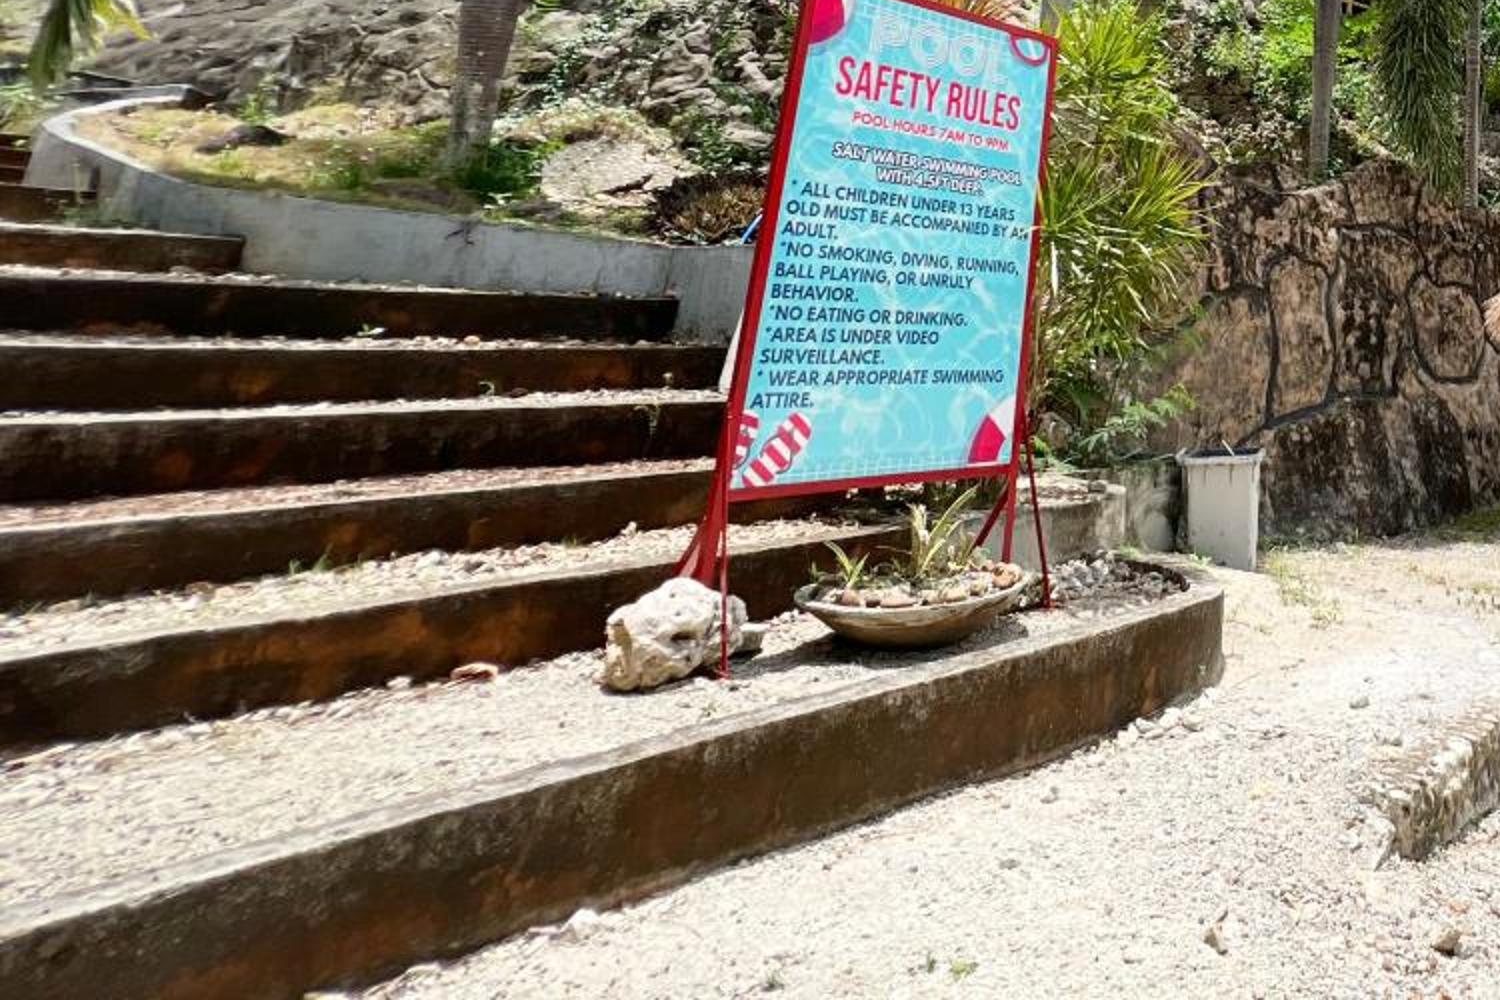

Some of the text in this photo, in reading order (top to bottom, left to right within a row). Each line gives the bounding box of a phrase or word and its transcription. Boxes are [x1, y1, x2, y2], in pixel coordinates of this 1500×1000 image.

[869, 12, 1008, 85] POOL
[835, 55, 1022, 131] SAFETY RULES
[851, 111, 891, 130] POOL
[893, 120, 936, 137] HOURS
[938, 127, 966, 143] 7AM
[968, 133, 983, 147] TO
[832, 141, 1022, 186] SALT WATER SWIMMING POOL
[876, 166, 914, 185] WITH
[801, 181, 1016, 221] ALL CHILDREN UNDER 13 YEARS
[781, 219, 839, 240] ADULT.
[786, 199, 821, 217] OLD
[823, 204, 869, 222] MUST
[869, 209, 889, 225] BE
[889, 212, 991, 236] ACCOMPANIED
[991, 223, 1009, 237] BY
[818, 245, 897, 266] SMOKING,
[901, 251, 953, 271] DIVING,
[956, 257, 1020, 277] RUNNING,
[774, 262, 975, 290] BALL PLAYING, OR UNRULY
[770, 283, 859, 303] BEHAVIOR.
[807, 306, 865, 323] EATING
[869, 309, 891, 325] OR
[894, 309, 968, 328] DRINKING.
[821, 327, 837, 343] IS
[841, 328, 892, 345] UNDER
[896, 330, 940, 345] VIDEO
[759, 347, 886, 366] SURVEILLANCE.
[768, 368, 1004, 387] WEAR APPROPRIATE SWIMMING
[749, 391, 815, 410] ATTIRE.
